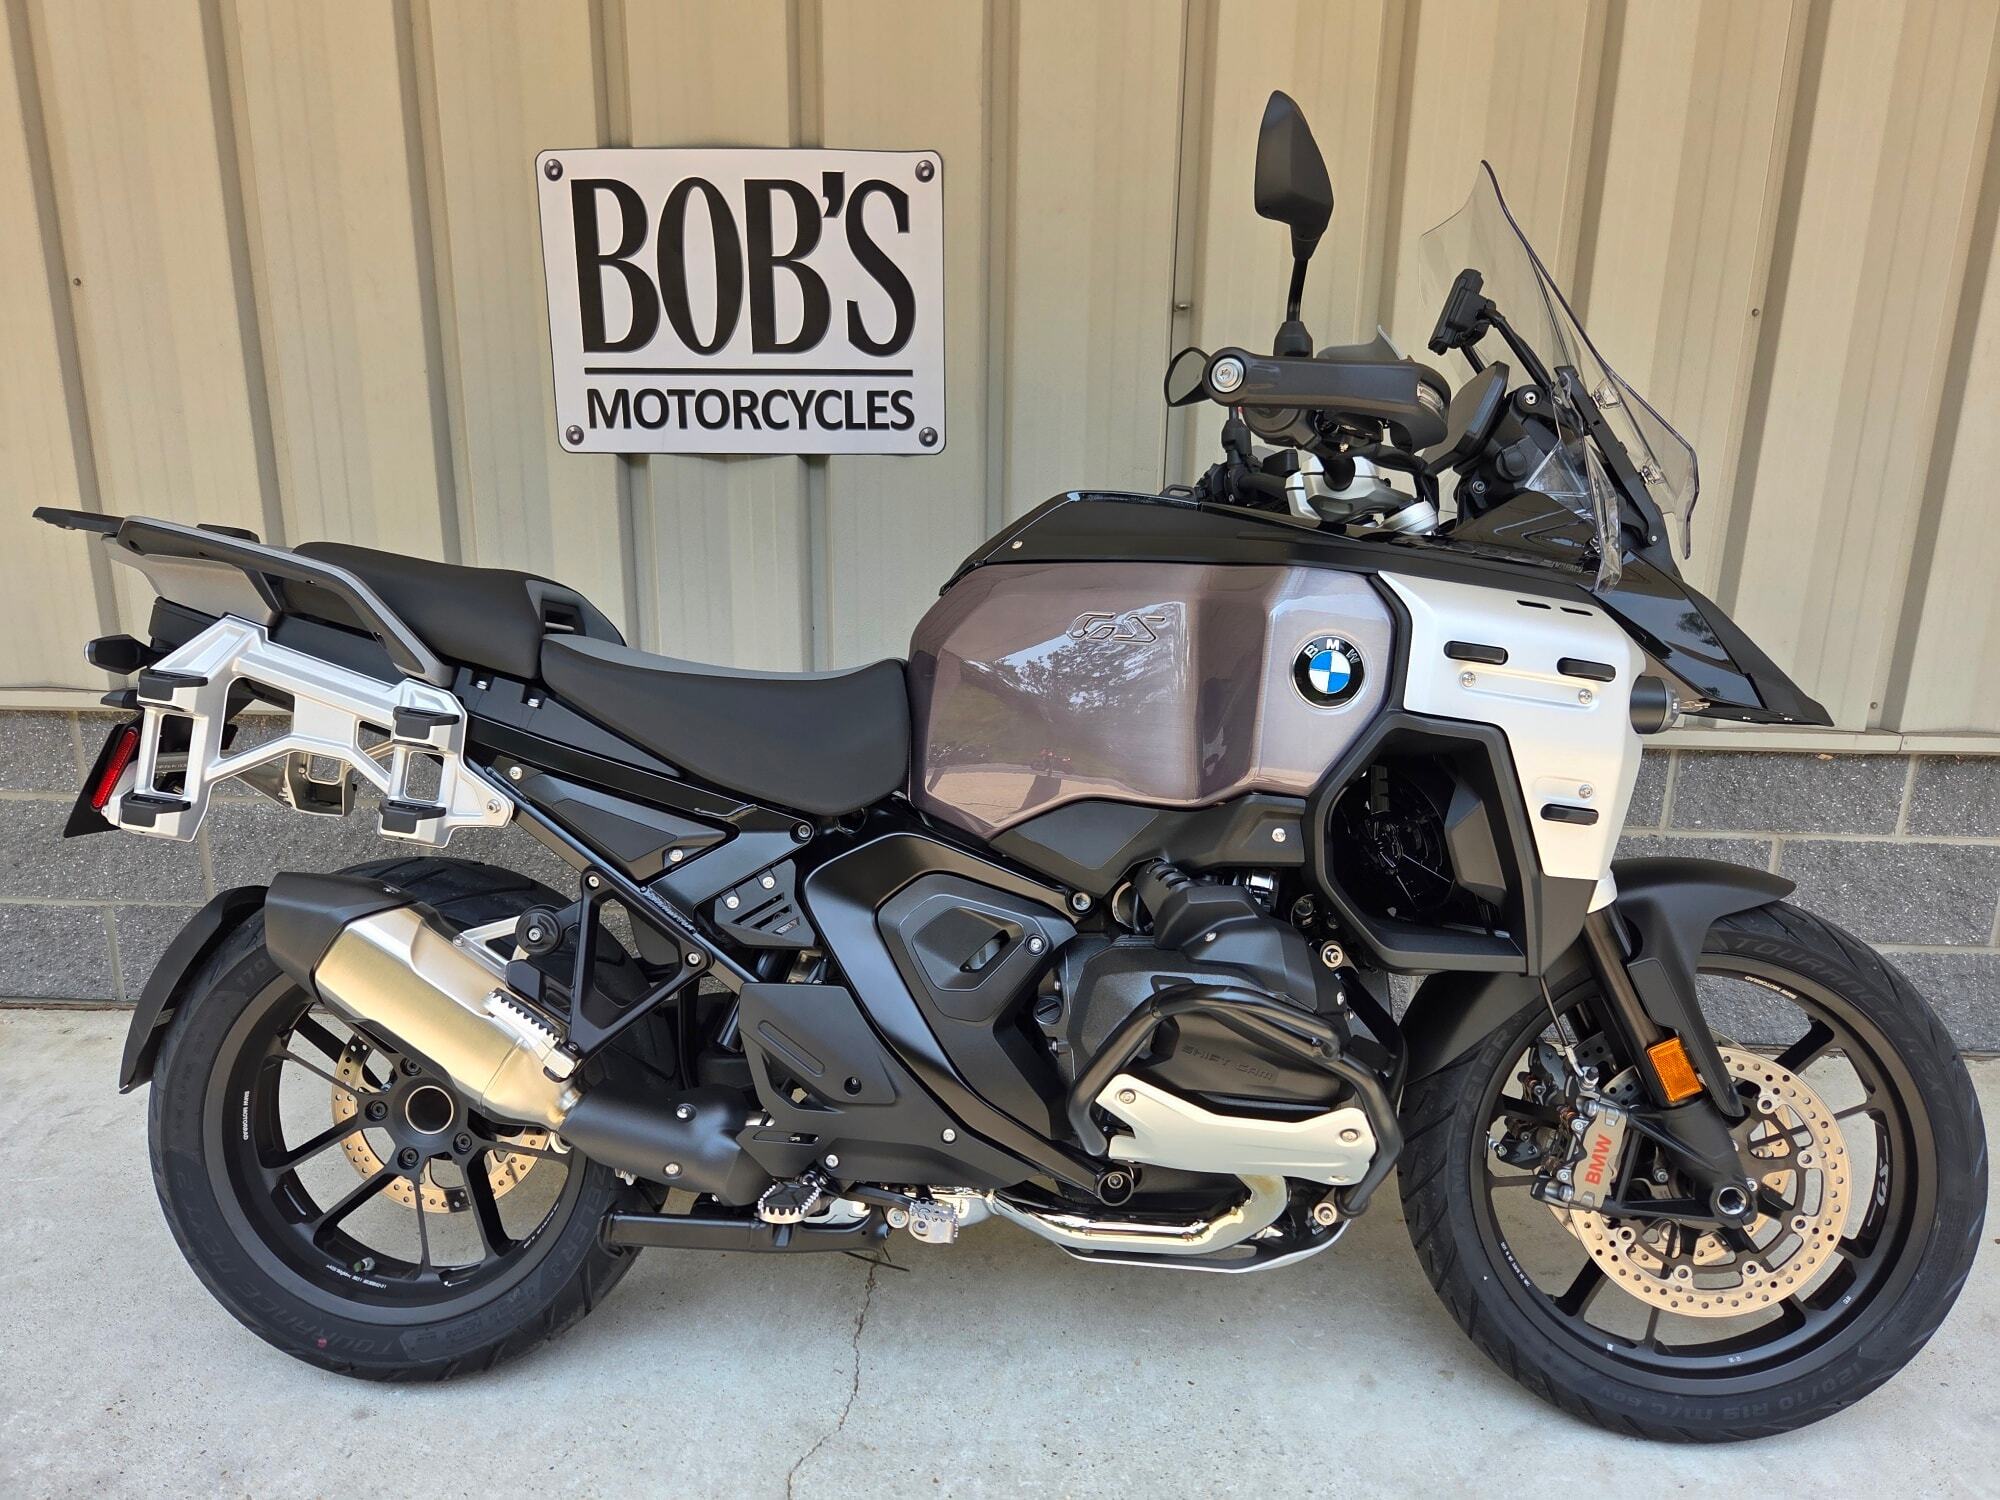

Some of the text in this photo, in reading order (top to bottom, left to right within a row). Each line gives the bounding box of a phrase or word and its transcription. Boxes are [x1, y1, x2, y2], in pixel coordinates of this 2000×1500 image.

[570, 171, 916, 357] BOB'S
[586, 387, 915, 431] MOTORCYCLES
[1734, 936, 1899, 1027] TOURANCE
[1450, 1028, 1512, 1193] METZELER
[1584, 1133, 1613, 1185] BMW
[236, 1281, 396, 1355] TOURANCE
